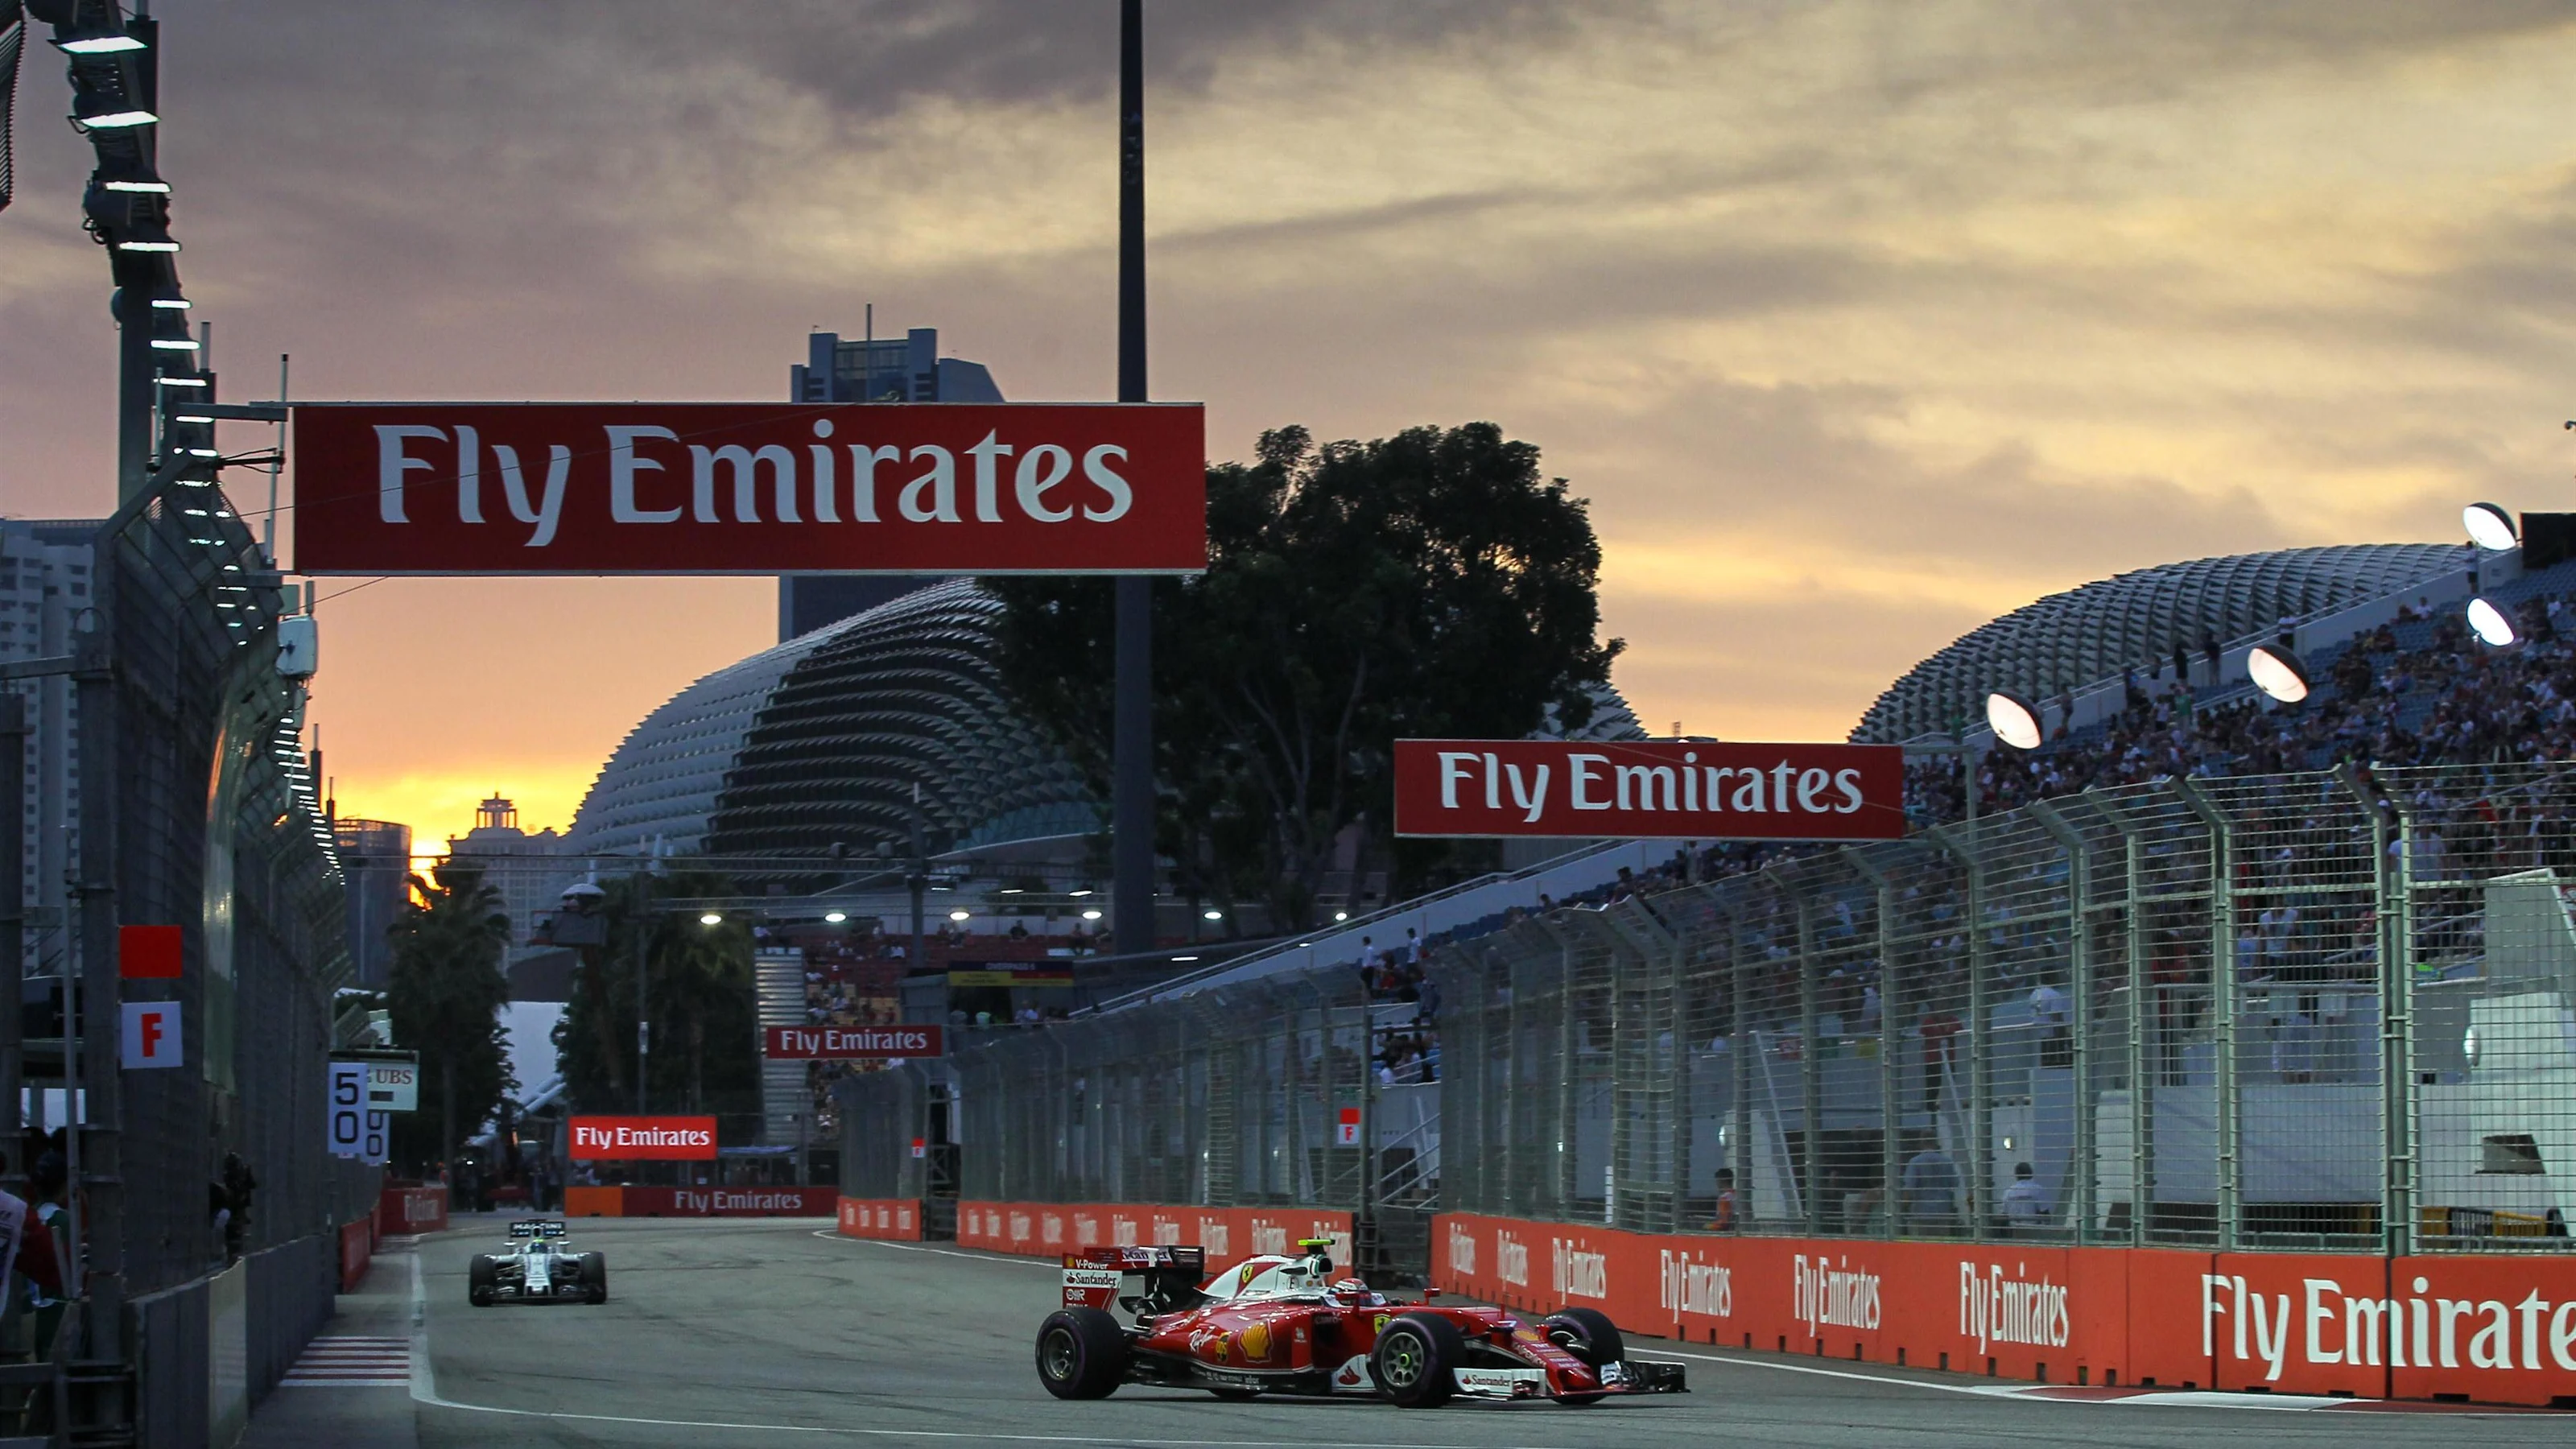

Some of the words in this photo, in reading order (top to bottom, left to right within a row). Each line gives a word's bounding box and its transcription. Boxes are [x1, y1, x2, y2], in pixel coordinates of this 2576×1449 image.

[372, 424, 572, 547] Fly
[602, 418, 1133, 526] Emirates
[1437, 752, 1550, 823] Fly
[1567, 751, 1864, 814] Emirates
[142, 1013, 163, 1058] F
[781, 1030, 819, 1055] Fly
[824, 1029, 927, 1050] Emirates
[376, 1069, 412, 1084] UBS
[576, 1127, 612, 1150] Fly
[617, 1127, 711, 1146] Emirates
[1345, 1126, 1353, 1141] F
[675, 1191, 708, 1212] Fly
[714, 1191, 803, 1210] Emirates
[1075, 1259, 1108, 1270] V-Power
[1075, 1272, 1117, 1286] Santander
[1661, 1249, 1679, 1323] Fly
[1680, 1250, 1731, 1317] Emirates
[1794, 1254, 1817, 1337] Fly
[1818, 1255, 1880, 1330] Emirates
[1960, 1261, 1988, 1355] Fly
[1990, 1261, 2070, 1348] Emirates
[2202, 1274, 2290, 1381] Fly
[1472, 1374, 1511, 1386] Santander
